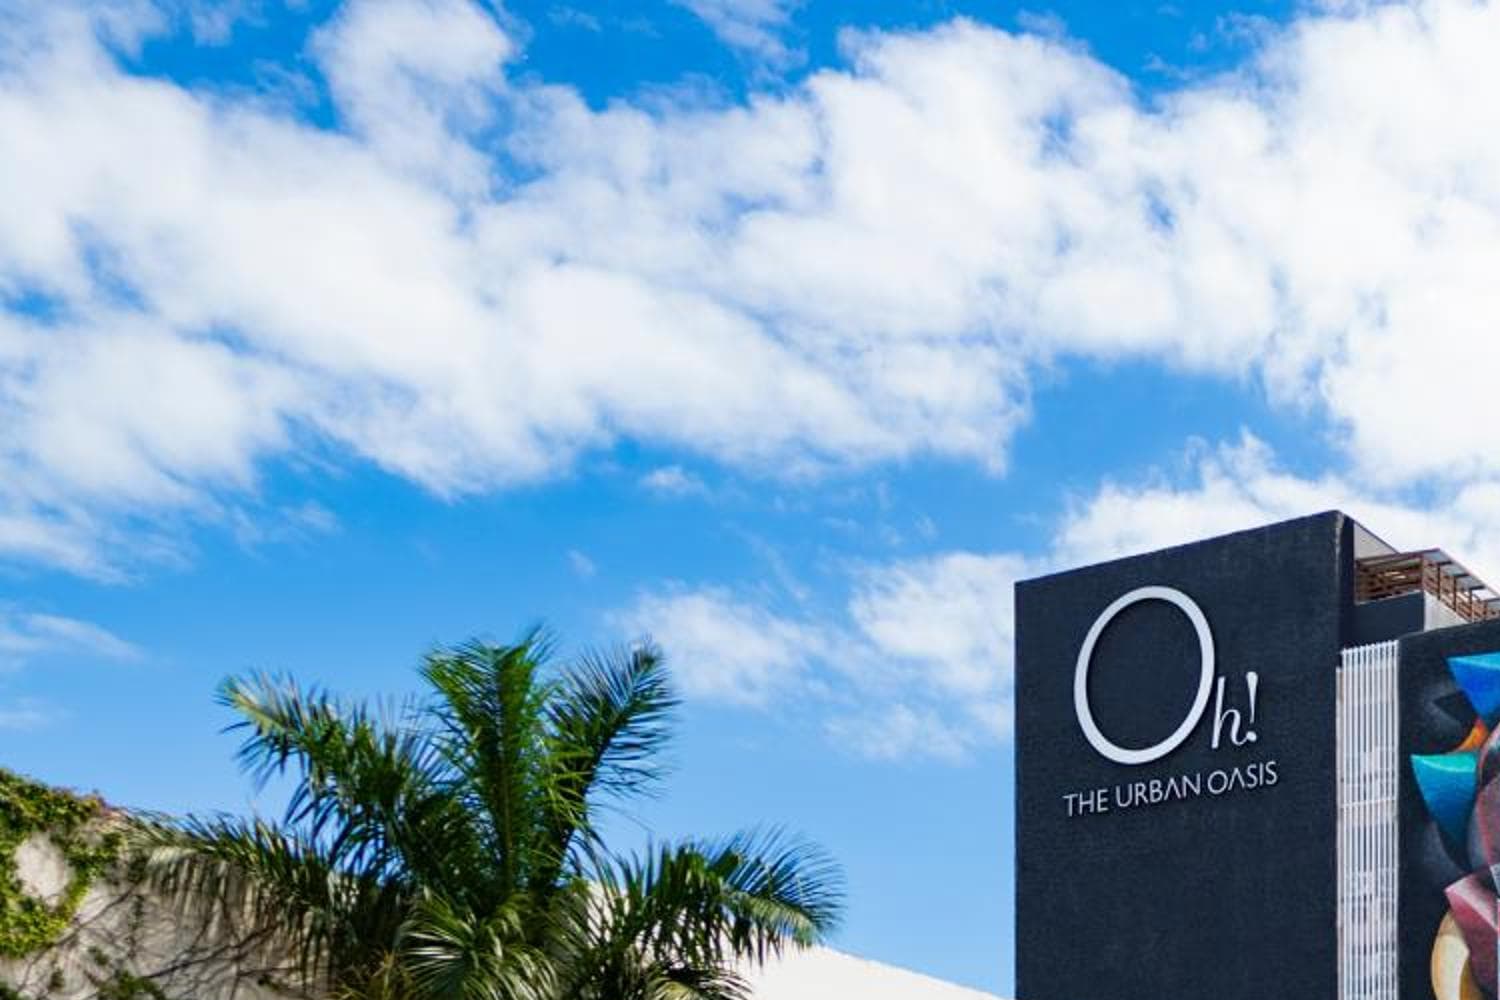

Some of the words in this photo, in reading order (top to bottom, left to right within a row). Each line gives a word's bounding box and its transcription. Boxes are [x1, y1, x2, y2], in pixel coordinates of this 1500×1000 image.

[1074, 585, 1258, 764] Oh!
[1063, 789, 1108, 816] THE
[1116, 773, 1200, 807] URBAN
[1207, 761, 1278, 794] OASIS
